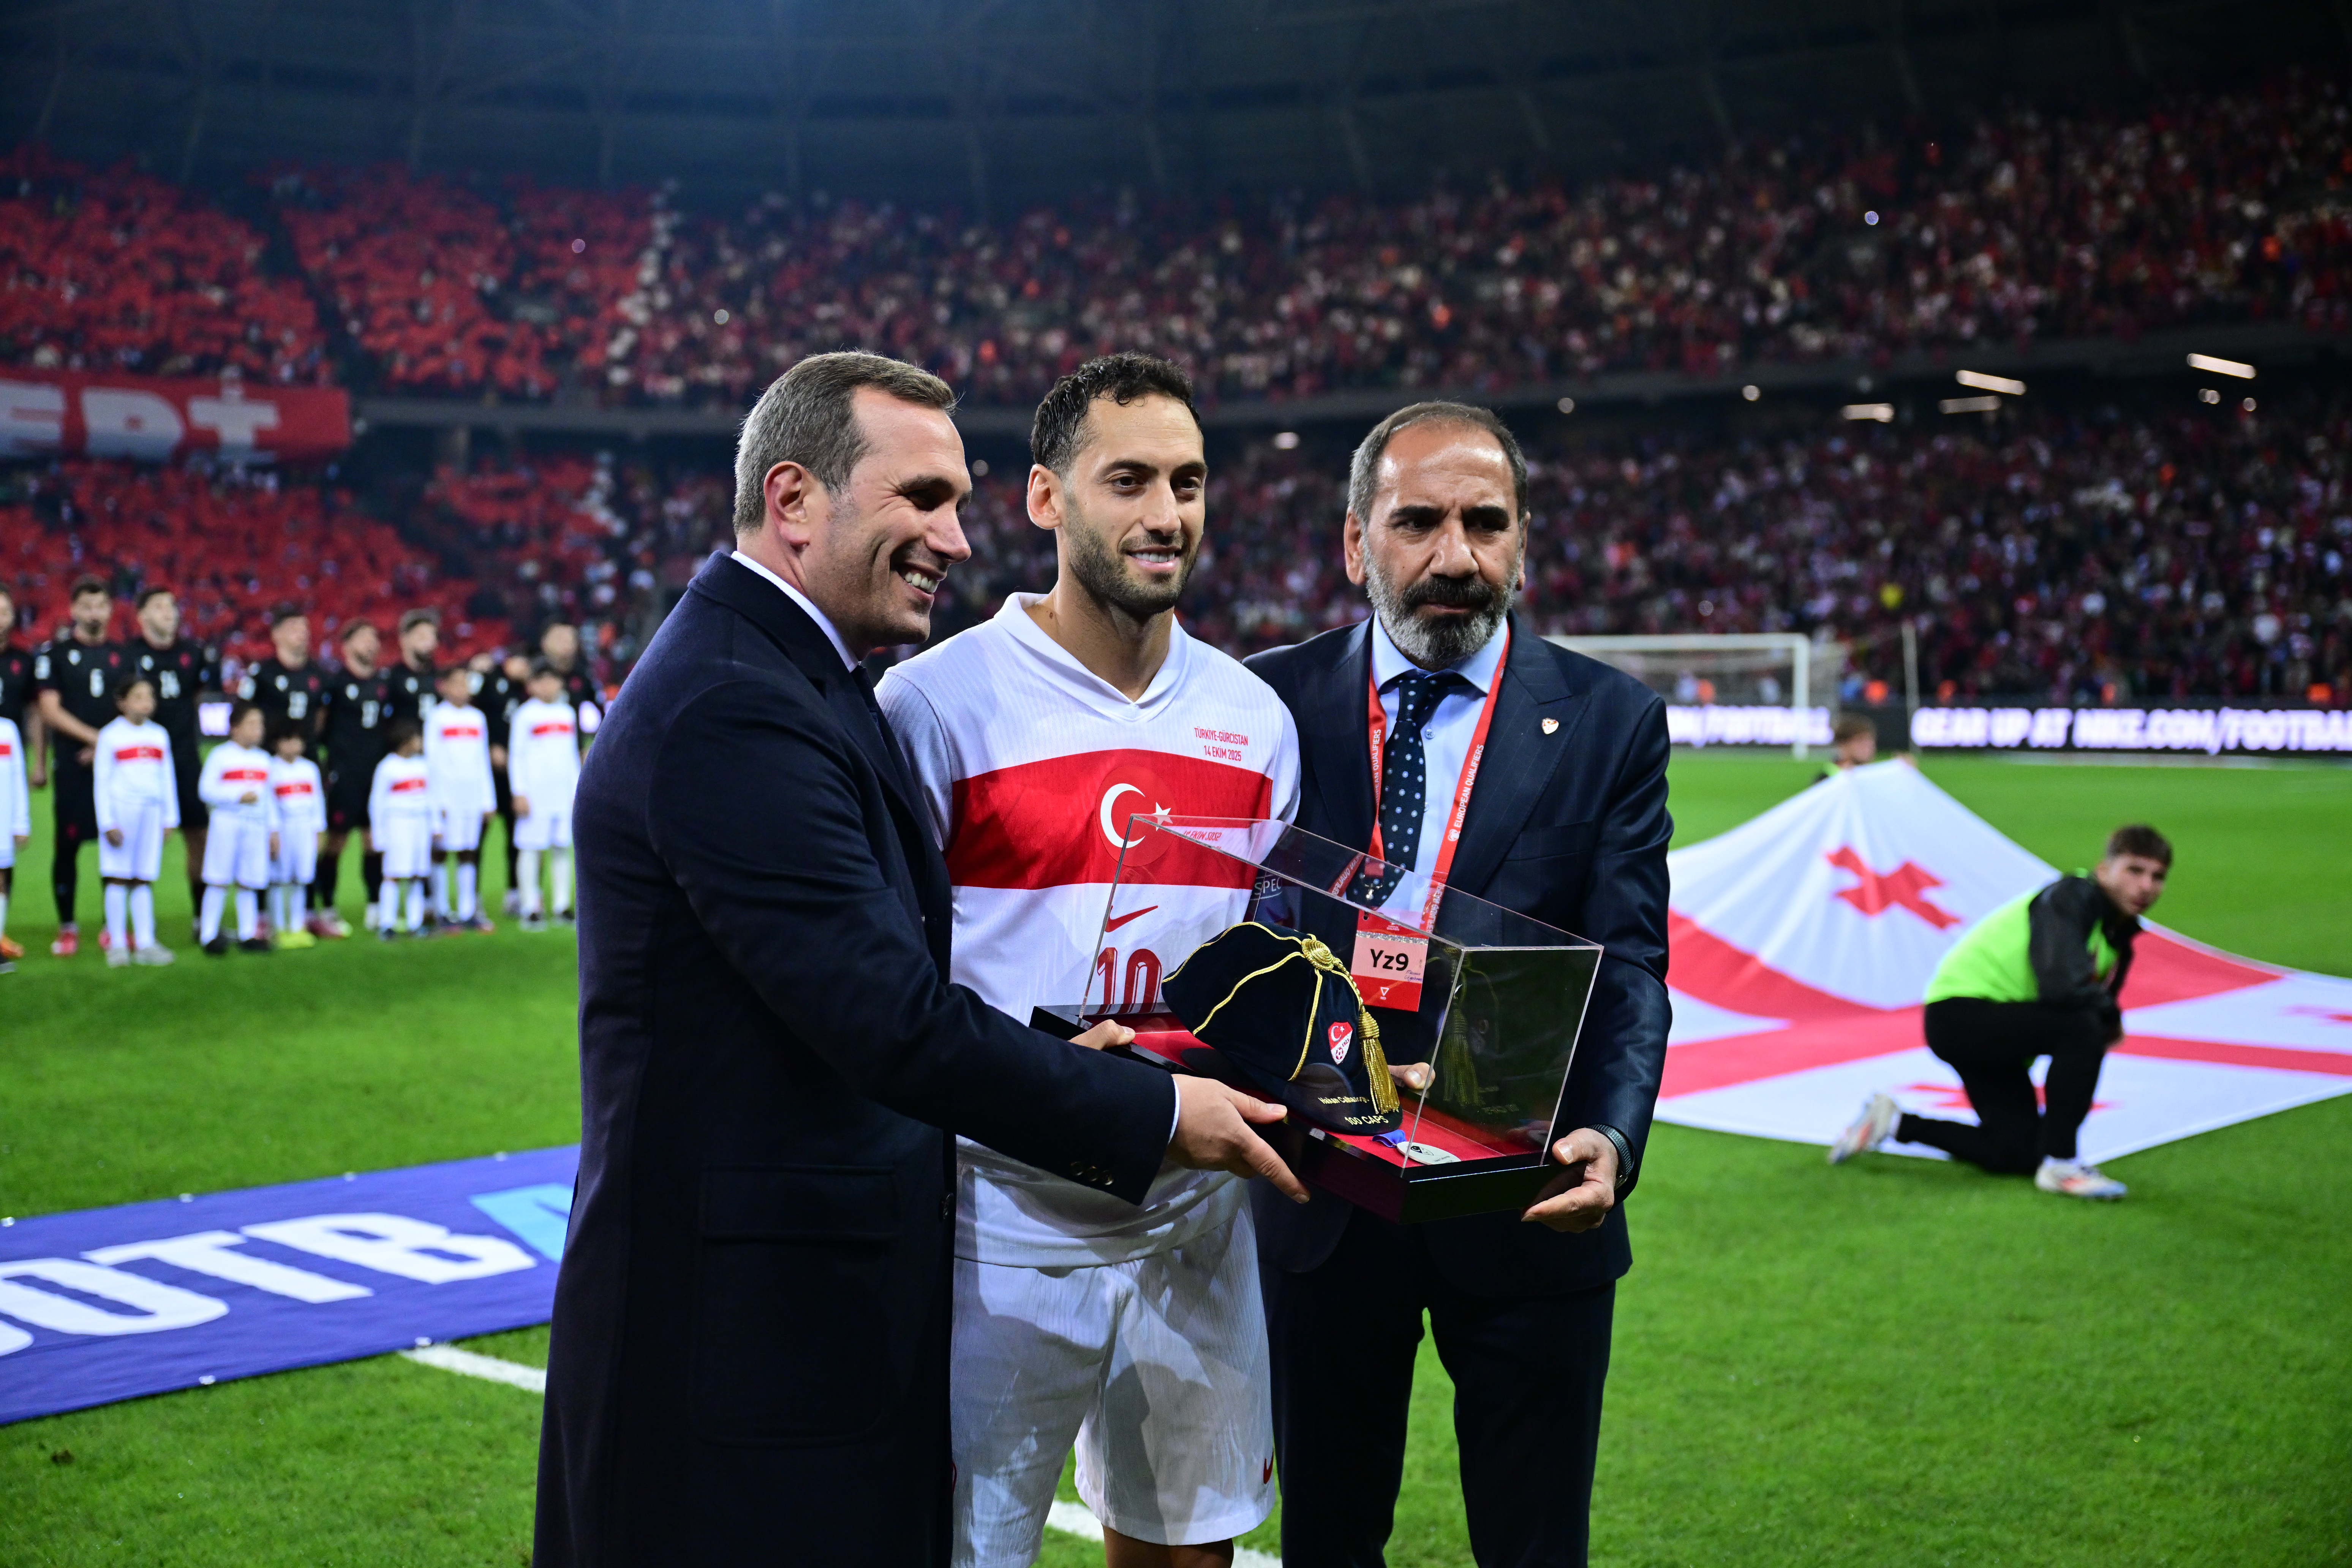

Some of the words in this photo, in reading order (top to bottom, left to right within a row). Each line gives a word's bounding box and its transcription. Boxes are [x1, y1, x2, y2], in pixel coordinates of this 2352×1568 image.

[1194, 726, 1248, 746] TÜRKİYE-GÜRCİSTAN
[1372, 729, 1381, 770] QUALIFIERS
[1204, 745, 1211, 756] 14
[1212, 746, 1227, 759] EKİM
[1228, 749, 1241, 761] 2025
[1454, 787, 1470, 828] EUROPEAN
[1465, 744, 1484, 785] QUALIFIERS
[1370, 949, 1409, 971] Yz9
[1097, 947, 1162, 1014] 10
[1345, 1116, 1363, 1125] 100
[1362, 1115, 1389, 1124] CAPS
[0, 1183, 575, 1356] OTB
